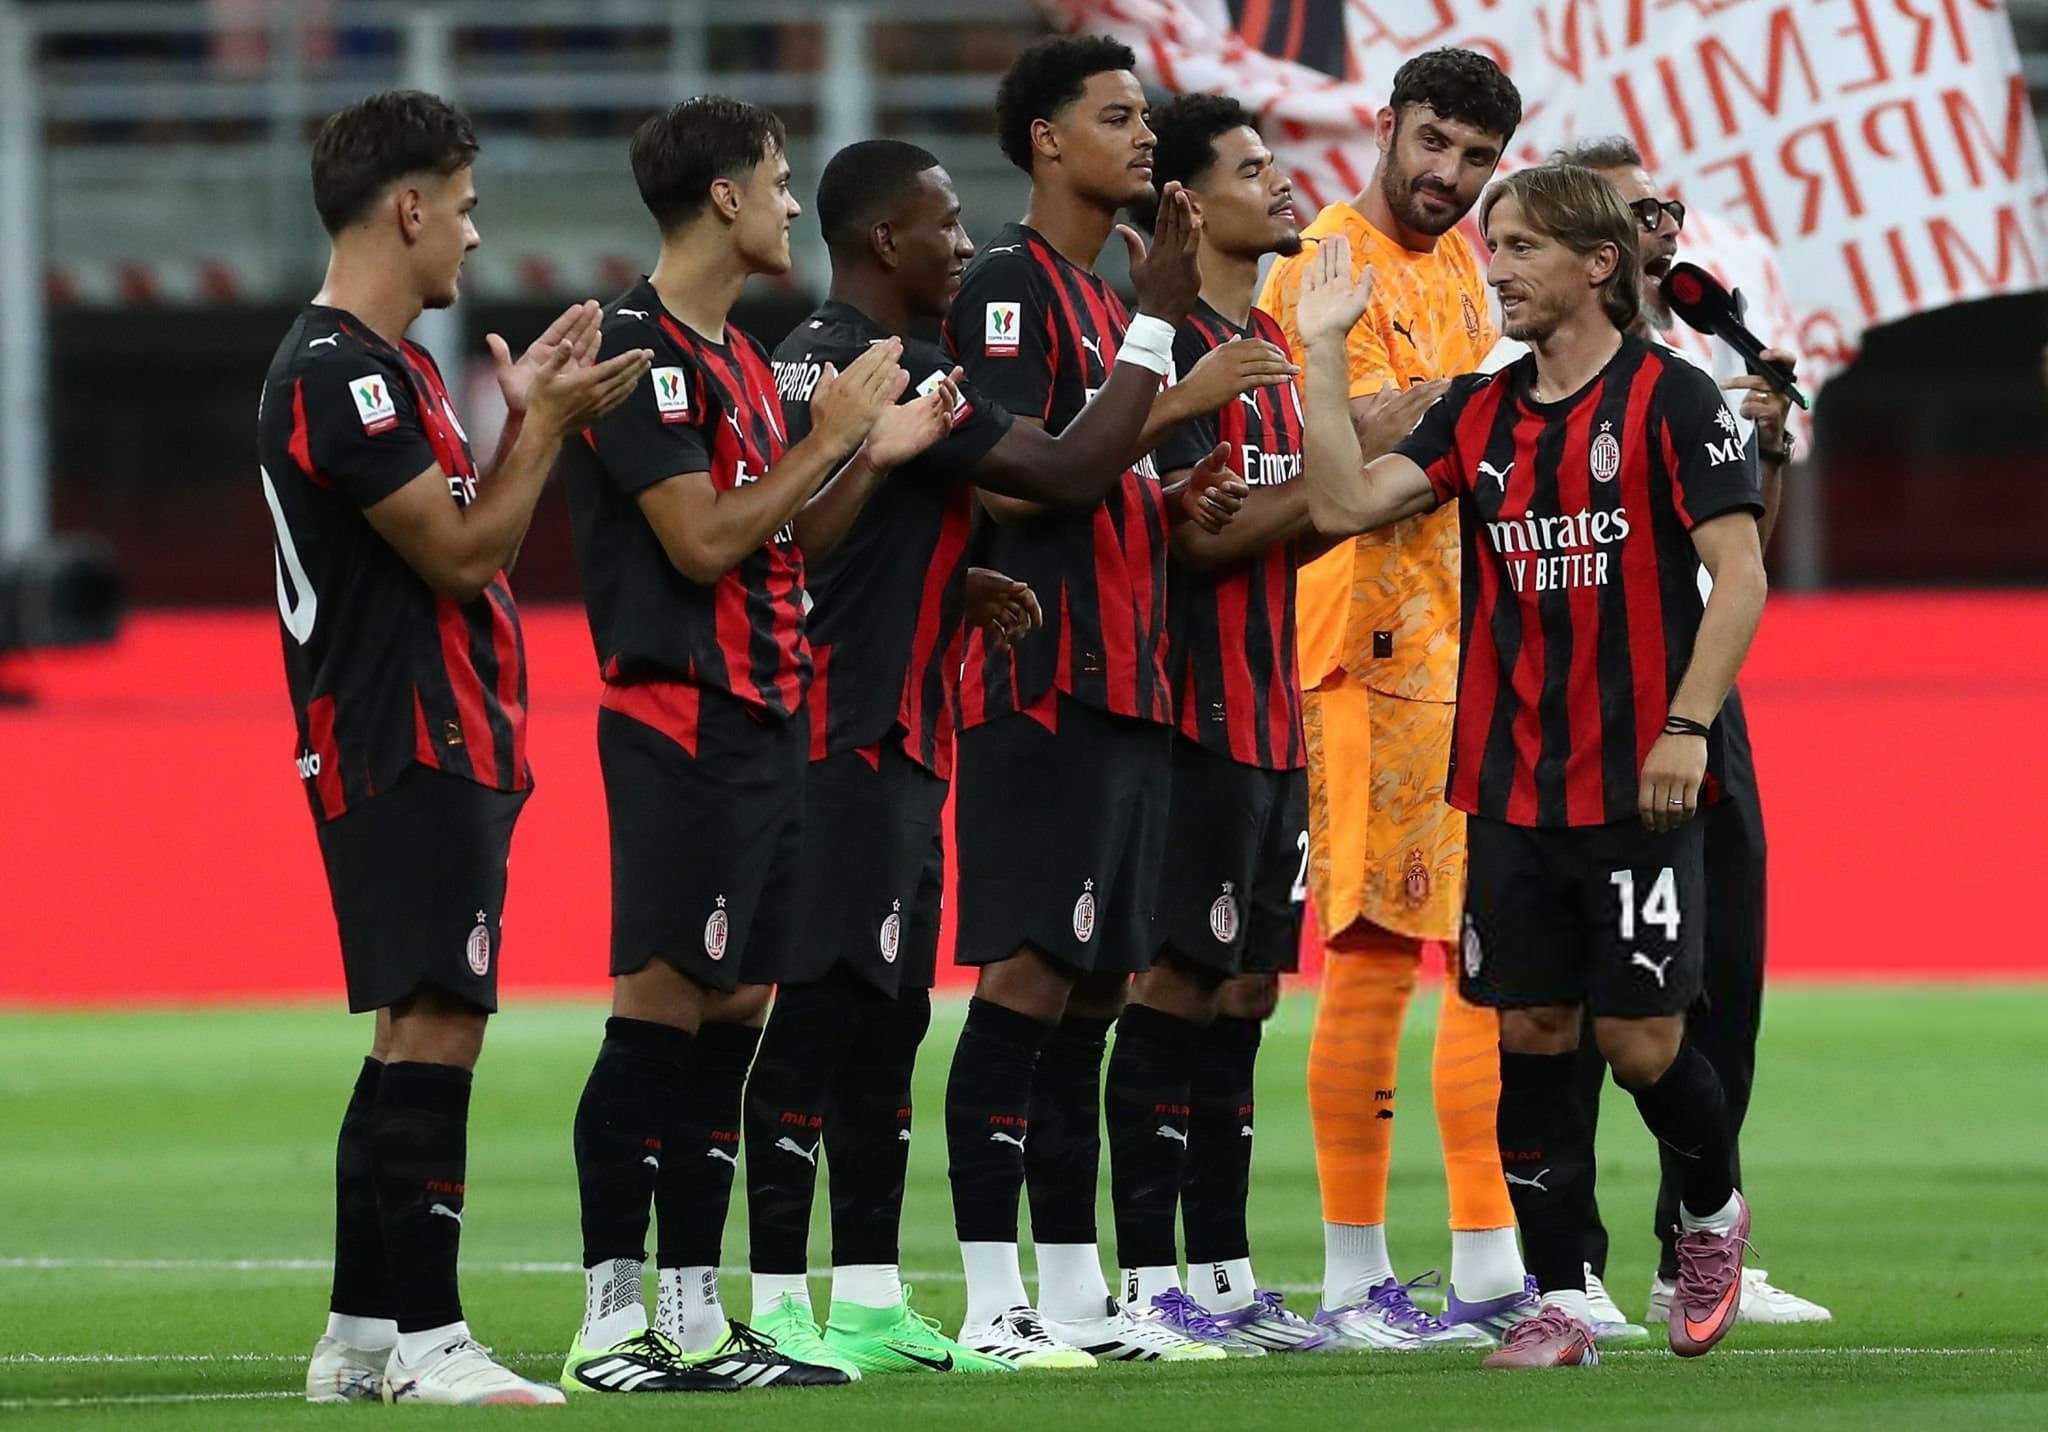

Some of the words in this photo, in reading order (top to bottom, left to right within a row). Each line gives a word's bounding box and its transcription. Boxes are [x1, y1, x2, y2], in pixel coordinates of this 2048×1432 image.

[1704, 437, 1746, 467] MS
[1486, 506, 1631, 553] mirates
[1535, 551, 1609, 592] BETTER
[1609, 867, 1681, 941] 14
